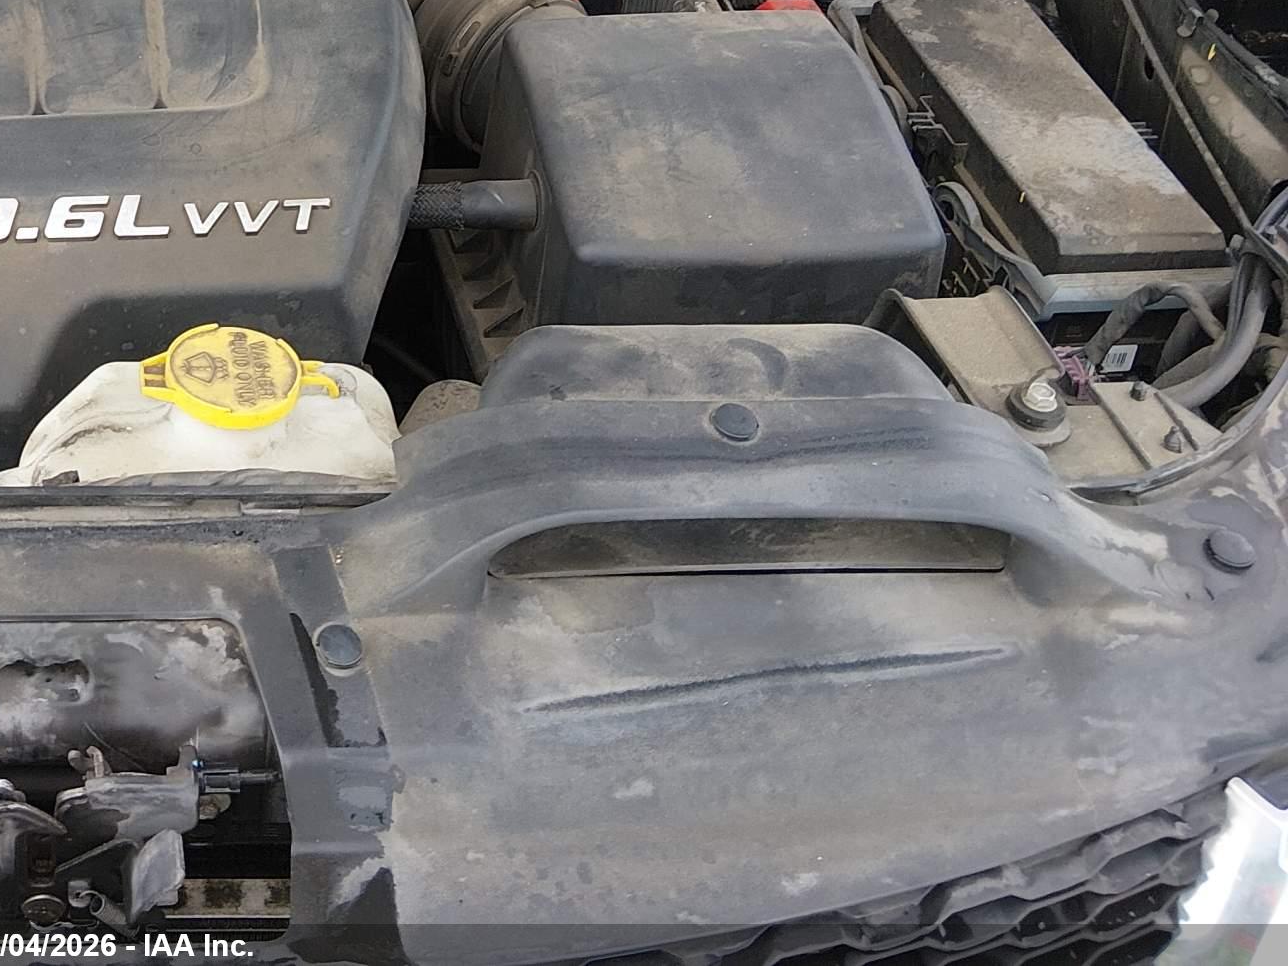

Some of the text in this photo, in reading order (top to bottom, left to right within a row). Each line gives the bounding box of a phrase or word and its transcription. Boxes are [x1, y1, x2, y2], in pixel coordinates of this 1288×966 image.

[184, 197, 332, 236] VVT
[228, 331, 256, 407] FLUID ONLY
[248, 340, 276, 400] WASHER
